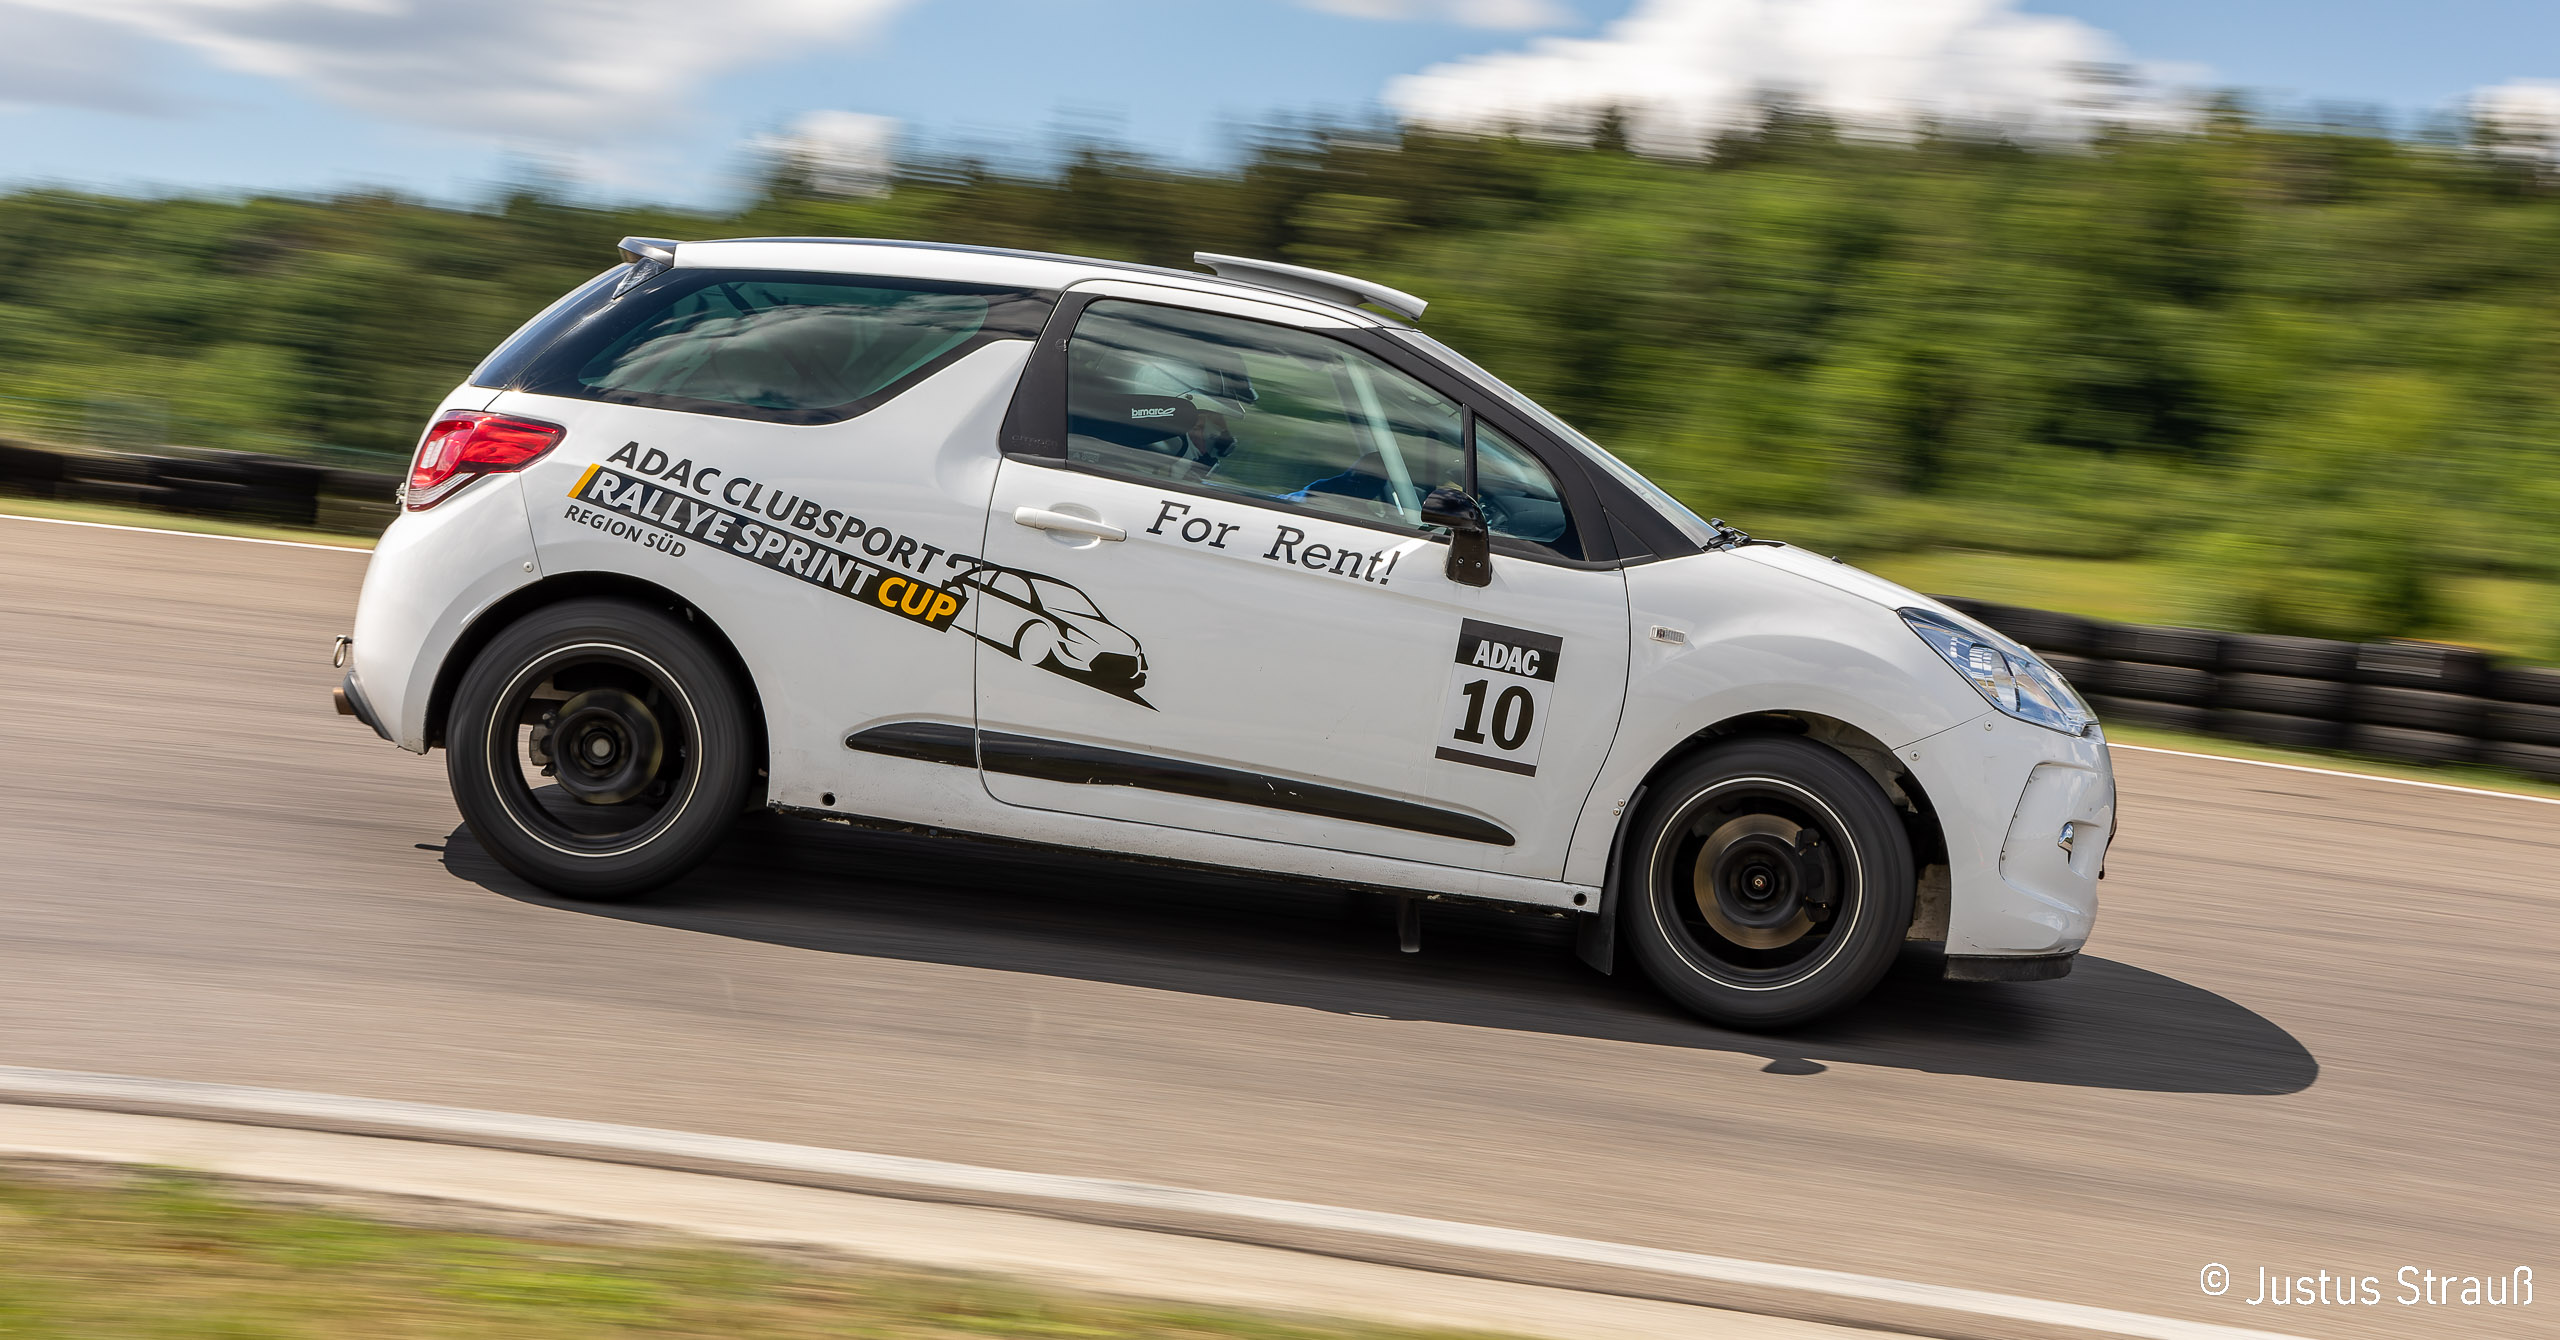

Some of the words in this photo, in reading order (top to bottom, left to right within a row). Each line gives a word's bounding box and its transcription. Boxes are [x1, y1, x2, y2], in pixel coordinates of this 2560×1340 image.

[564, 504, 643, 542] REGION
[644, 530, 686, 558] SÜD
[588, 470, 736, 545] RALLYE
[733, 524, 880, 595] SPRINT
[878, 576, 957, 622] CUP
[606, 441, 721, 495] ADAC
[723, 477, 945, 574] CLUBSPORT
[1146, 499, 1241, 549] For
[1263, 524, 1401, 585] Rent!
[1472, 639, 1540, 676] ADAC
[1453, 679, 1535, 751] 10
